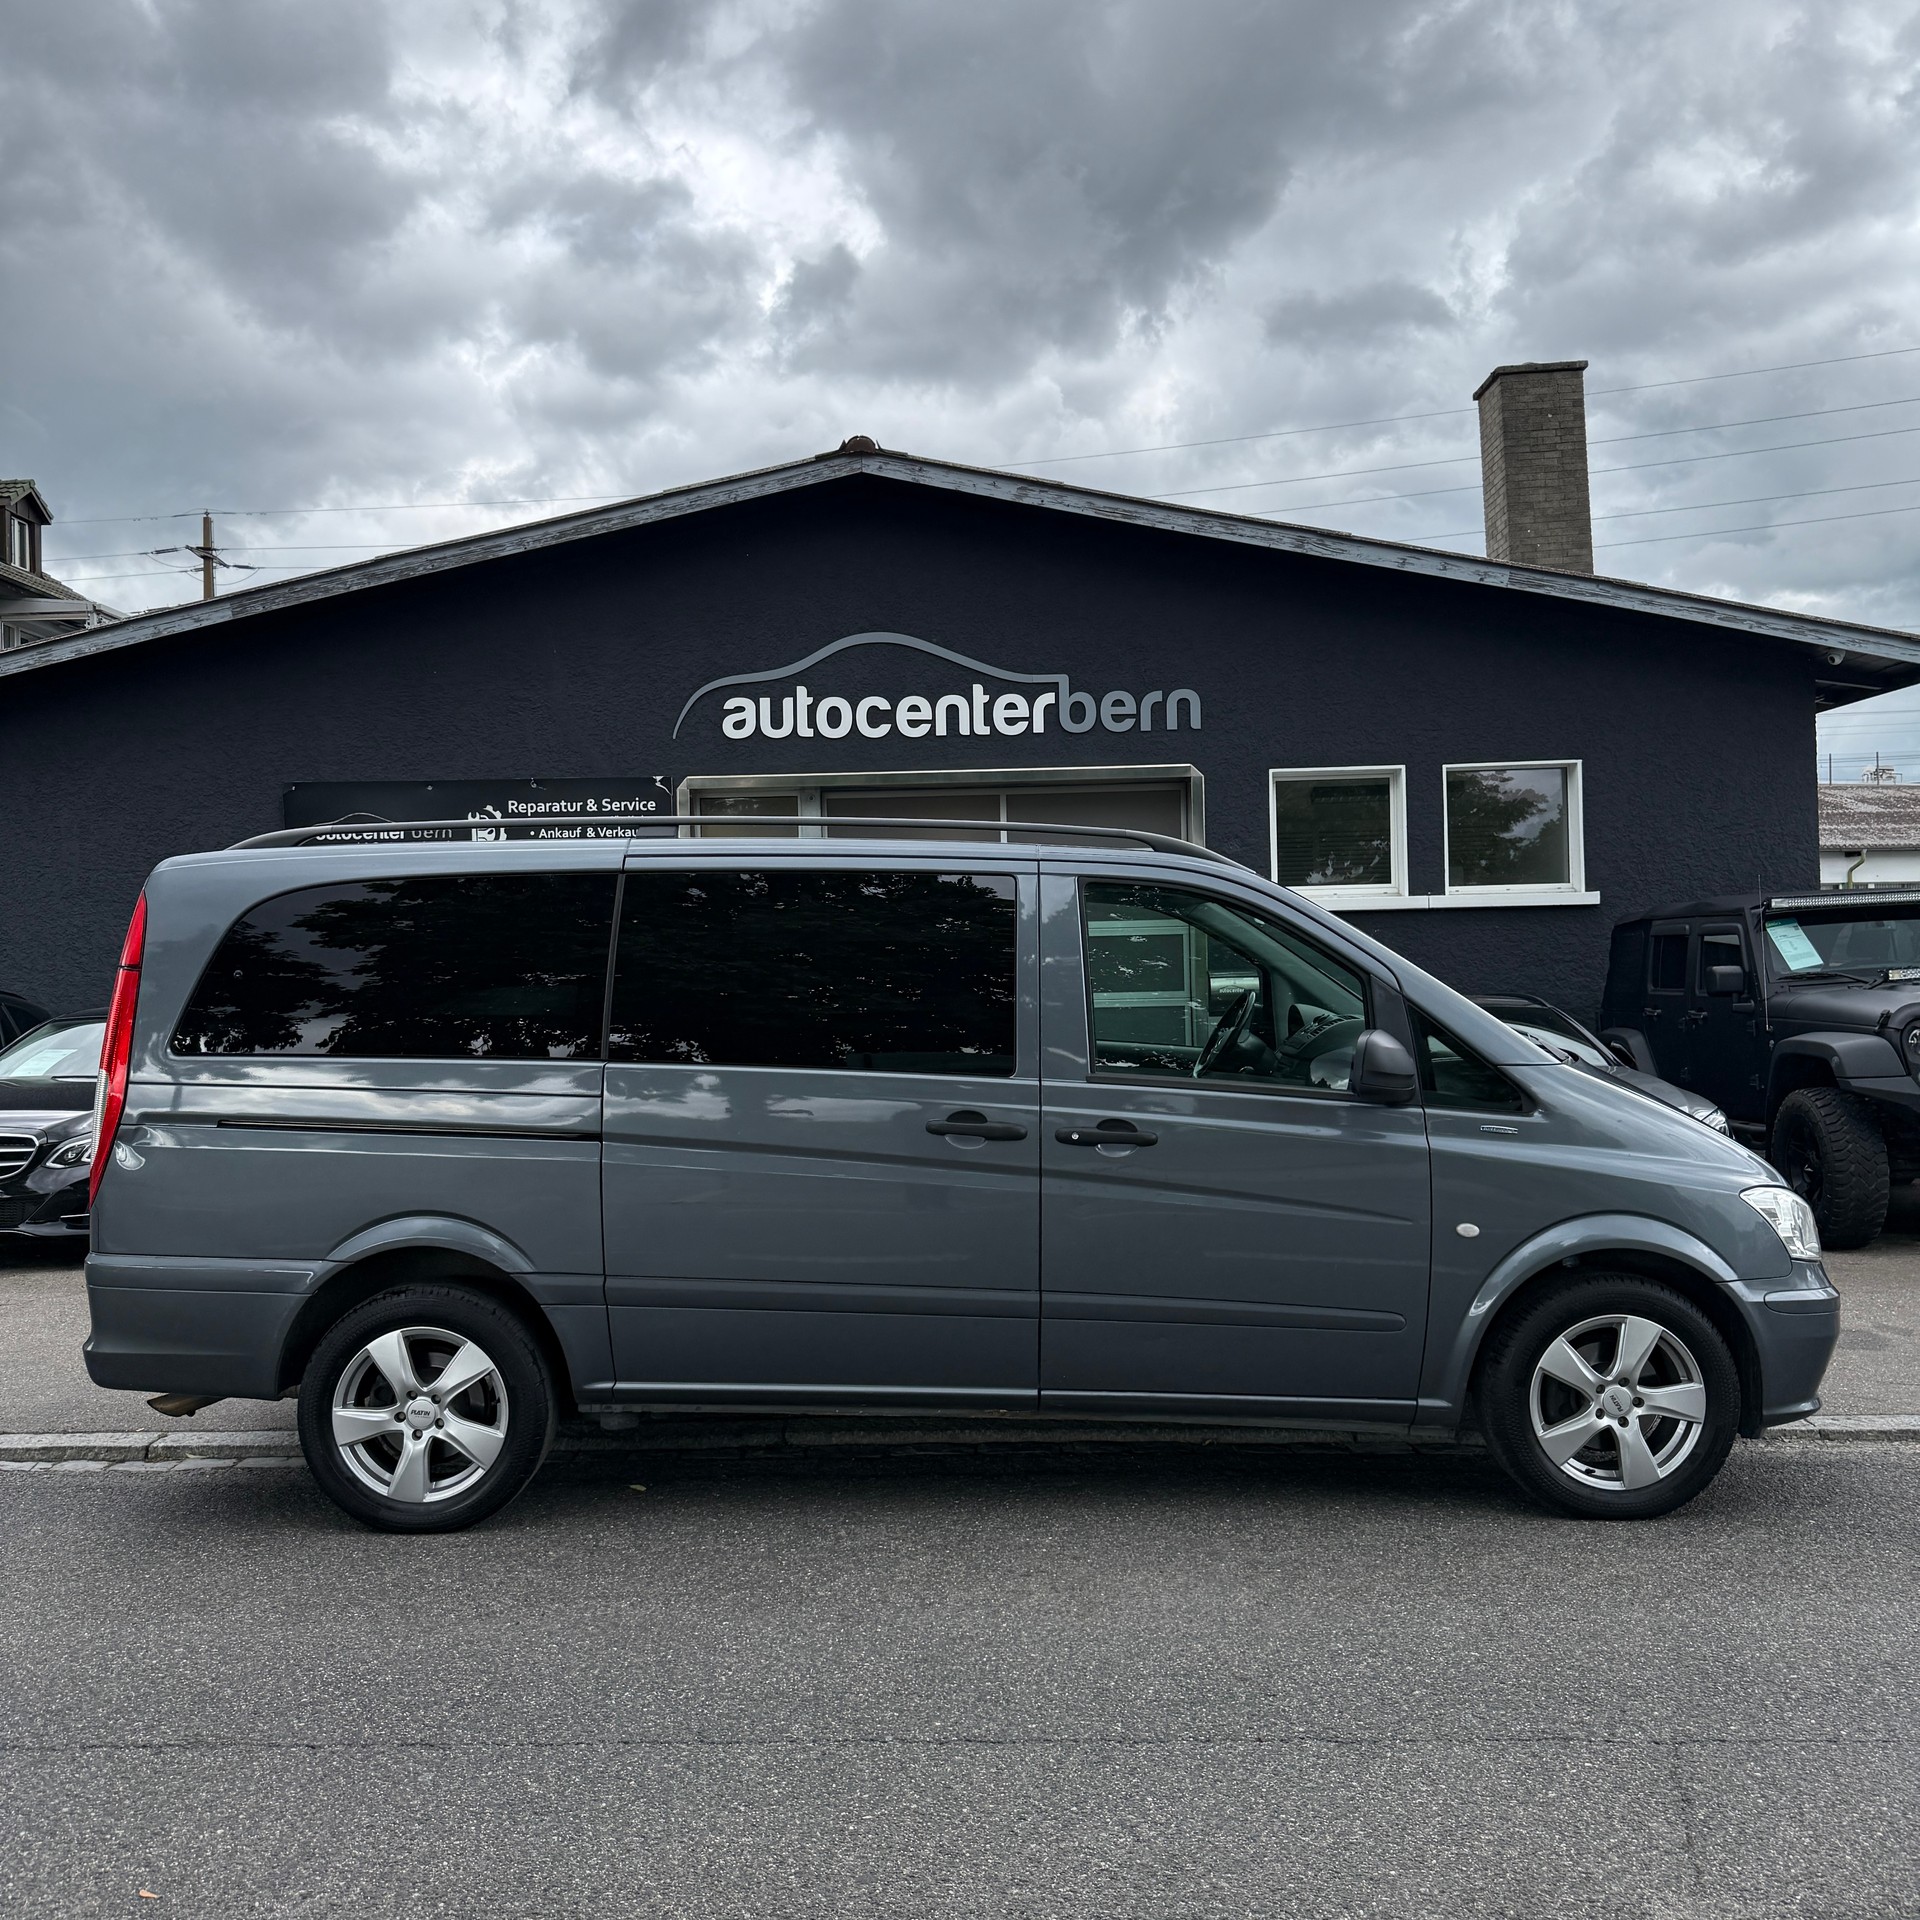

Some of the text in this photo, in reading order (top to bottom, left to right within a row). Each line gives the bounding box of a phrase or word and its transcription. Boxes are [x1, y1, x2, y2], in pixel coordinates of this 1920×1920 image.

[508, 797, 656, 816] Reparatur & Service
[538, 826, 638, 838] Ankauf & Verkau
